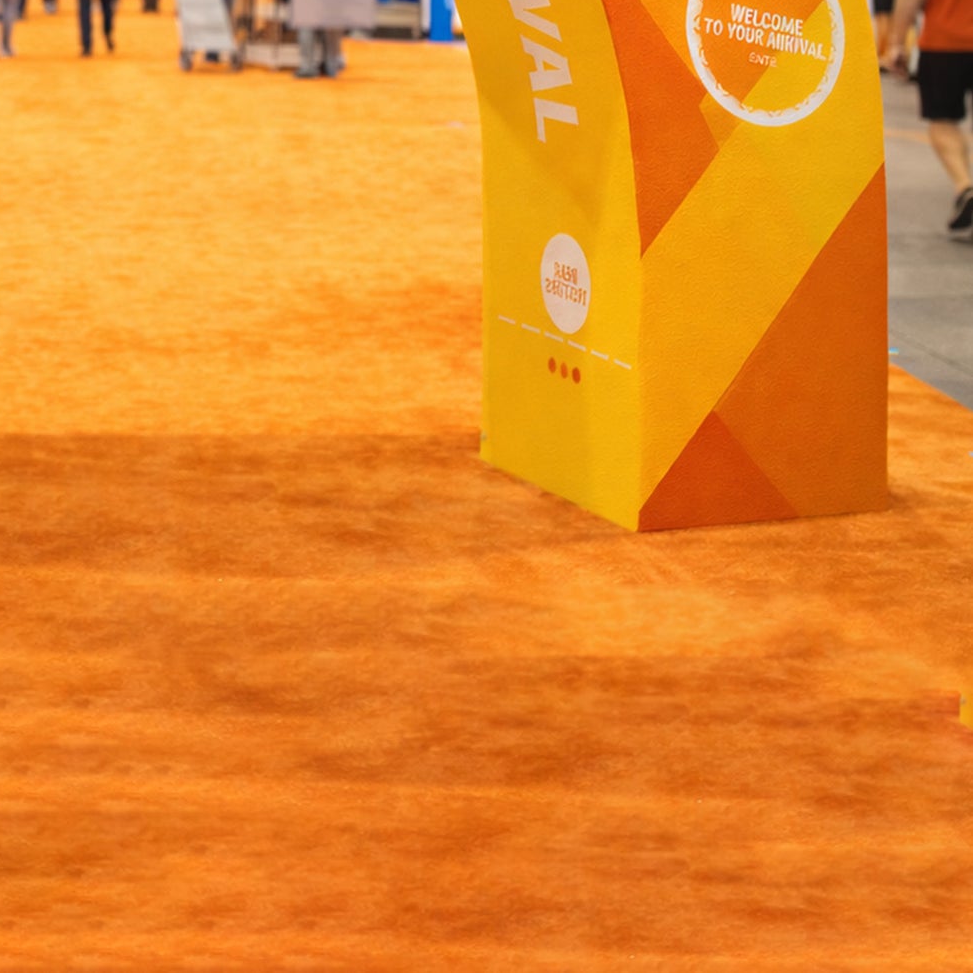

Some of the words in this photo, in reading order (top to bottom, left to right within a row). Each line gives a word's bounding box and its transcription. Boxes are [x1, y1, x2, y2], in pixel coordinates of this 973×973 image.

[704, 17, 723, 36] TO
[728, 23, 764, 46] YOUR
[731, 3, 803, 36] WELCOME
